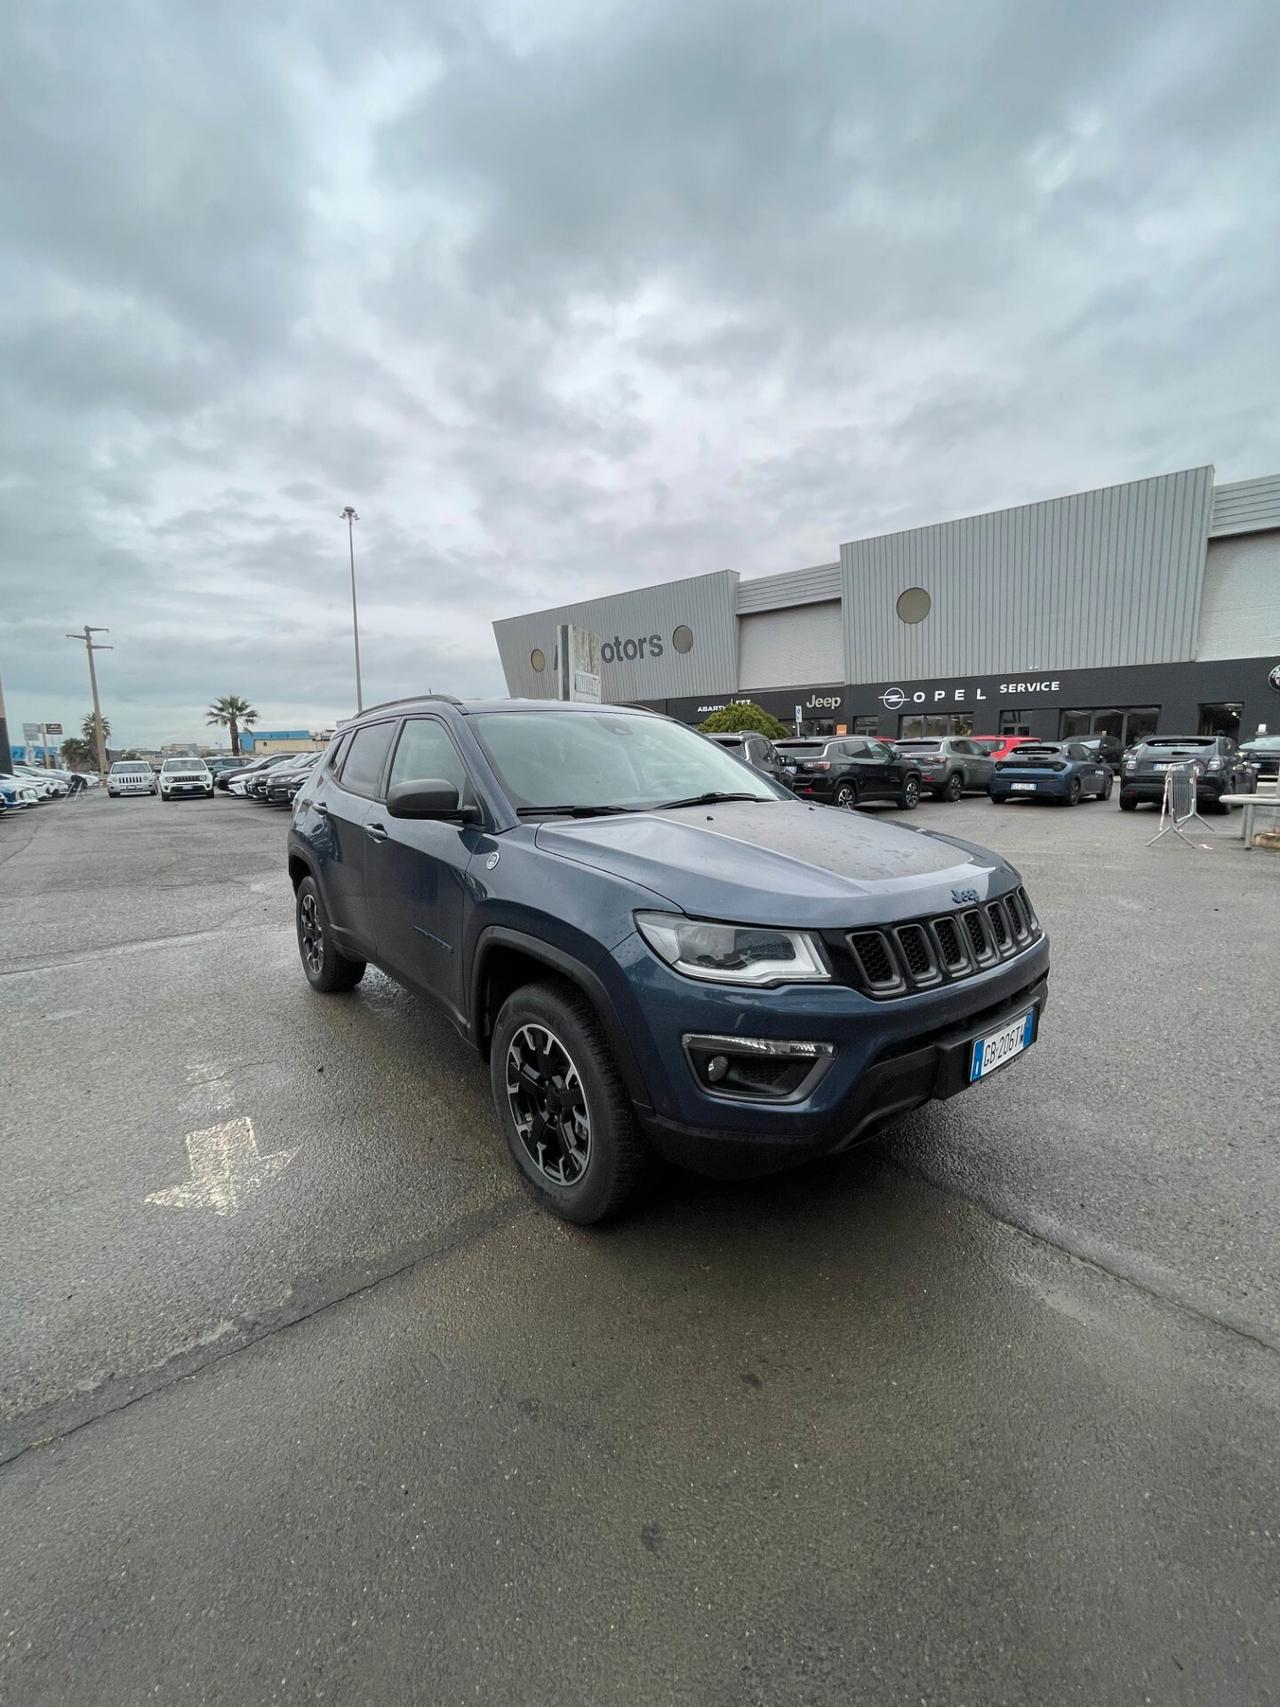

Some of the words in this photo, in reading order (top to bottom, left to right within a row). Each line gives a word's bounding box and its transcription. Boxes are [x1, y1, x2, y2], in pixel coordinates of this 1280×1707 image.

[600, 634, 664, 664] otors
[1000, 681, 1060, 693] SERVICE
[806, 694, 842, 710] Jeep
[913, 688, 987, 703] OPEL
